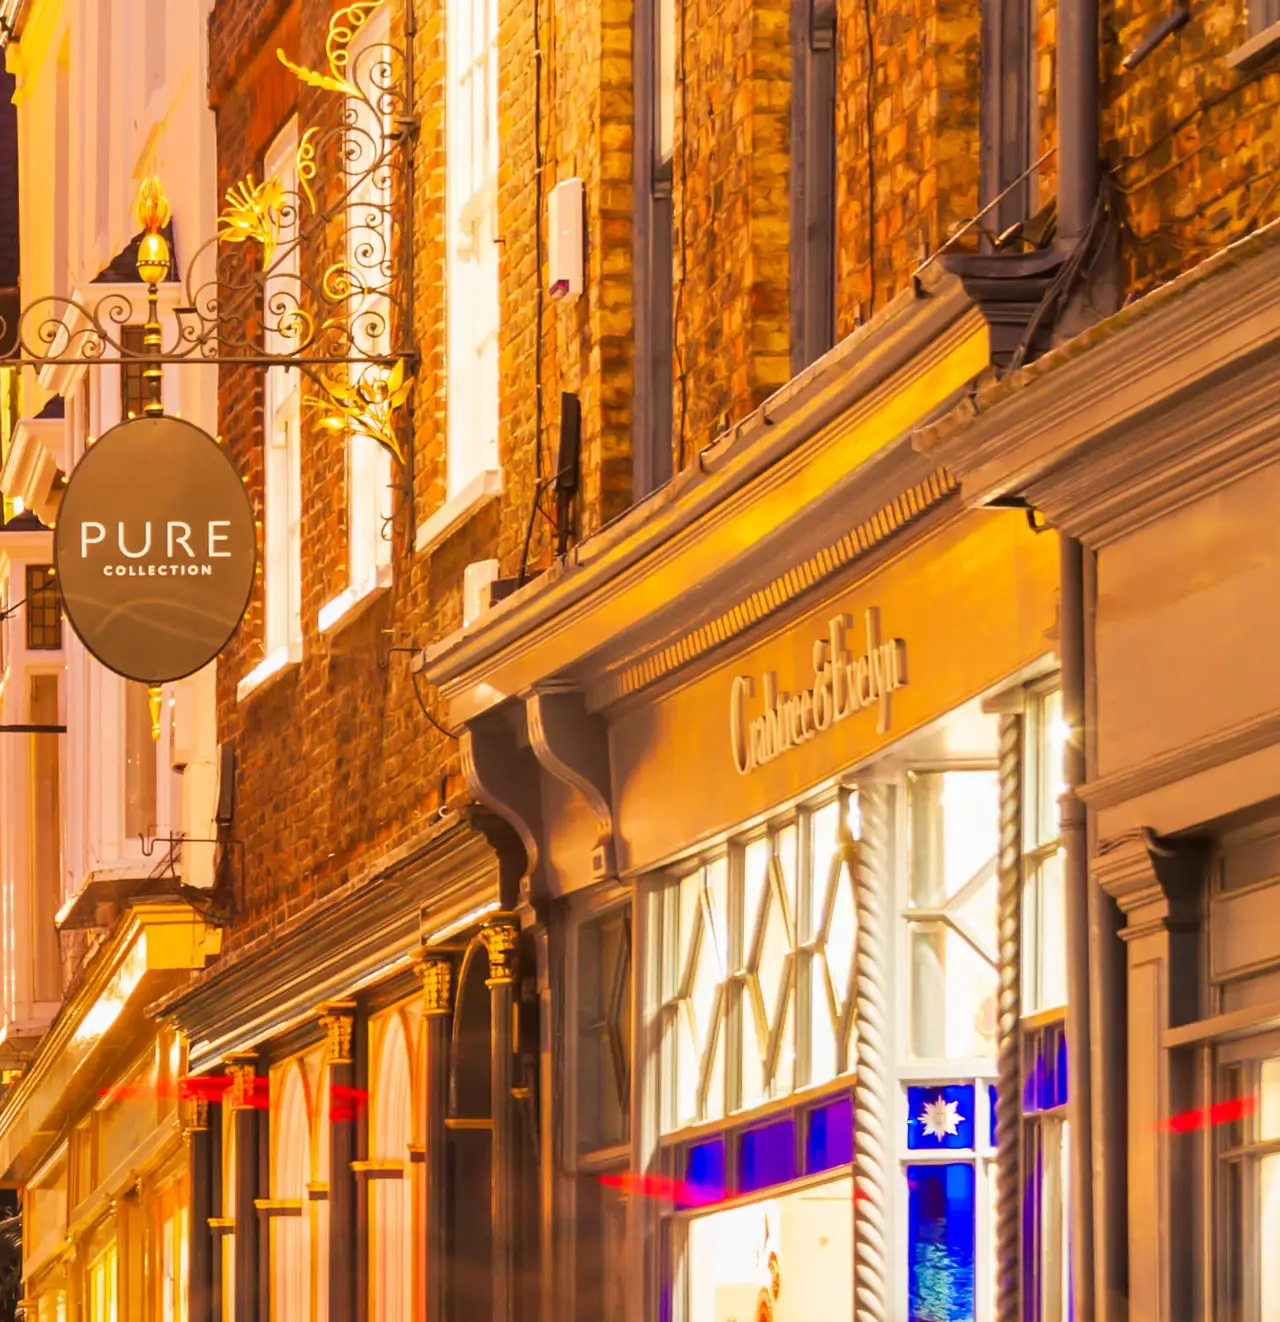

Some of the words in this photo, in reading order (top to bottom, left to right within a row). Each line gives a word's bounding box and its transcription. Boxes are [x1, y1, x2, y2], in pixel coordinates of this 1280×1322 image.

[81, 520, 232, 558] PURE
[103, 565, 212, 576] COLLECTION
[730, 671, 817, 775] Crabtree
[829, 606, 908, 734] Evelyn
